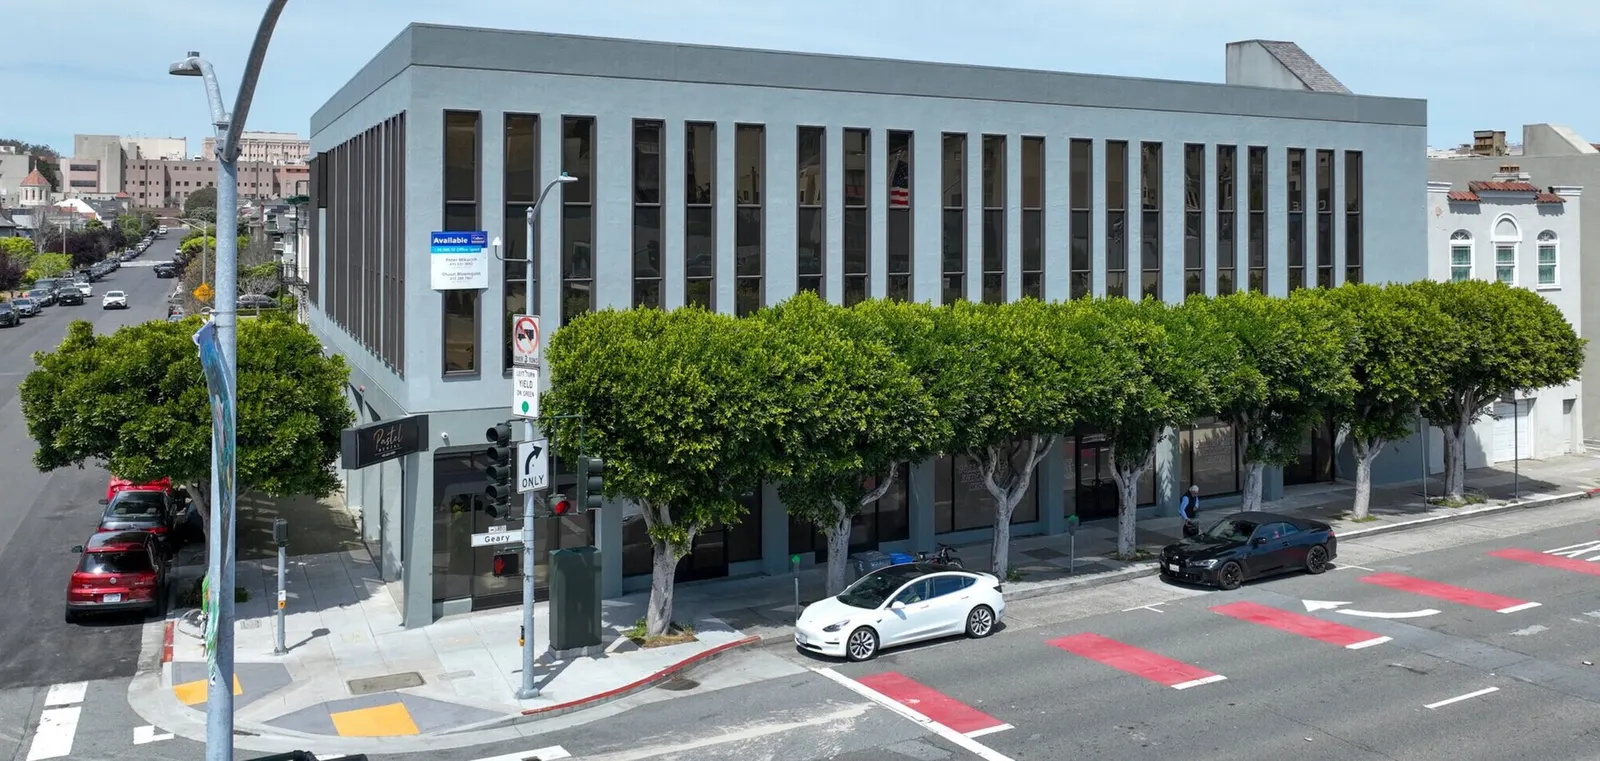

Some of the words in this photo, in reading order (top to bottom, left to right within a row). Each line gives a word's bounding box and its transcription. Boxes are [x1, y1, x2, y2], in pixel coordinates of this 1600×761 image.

[524, 355, 528, 363] 3
[518, 379, 533, 389] YIELD
[516, 389, 522, 397] ON
[523, 390, 535, 398] GREEN
[373, 423, 404, 451] Pastel
[522, 474, 545, 489] ONLY
[484, 535, 510, 543] Geary
